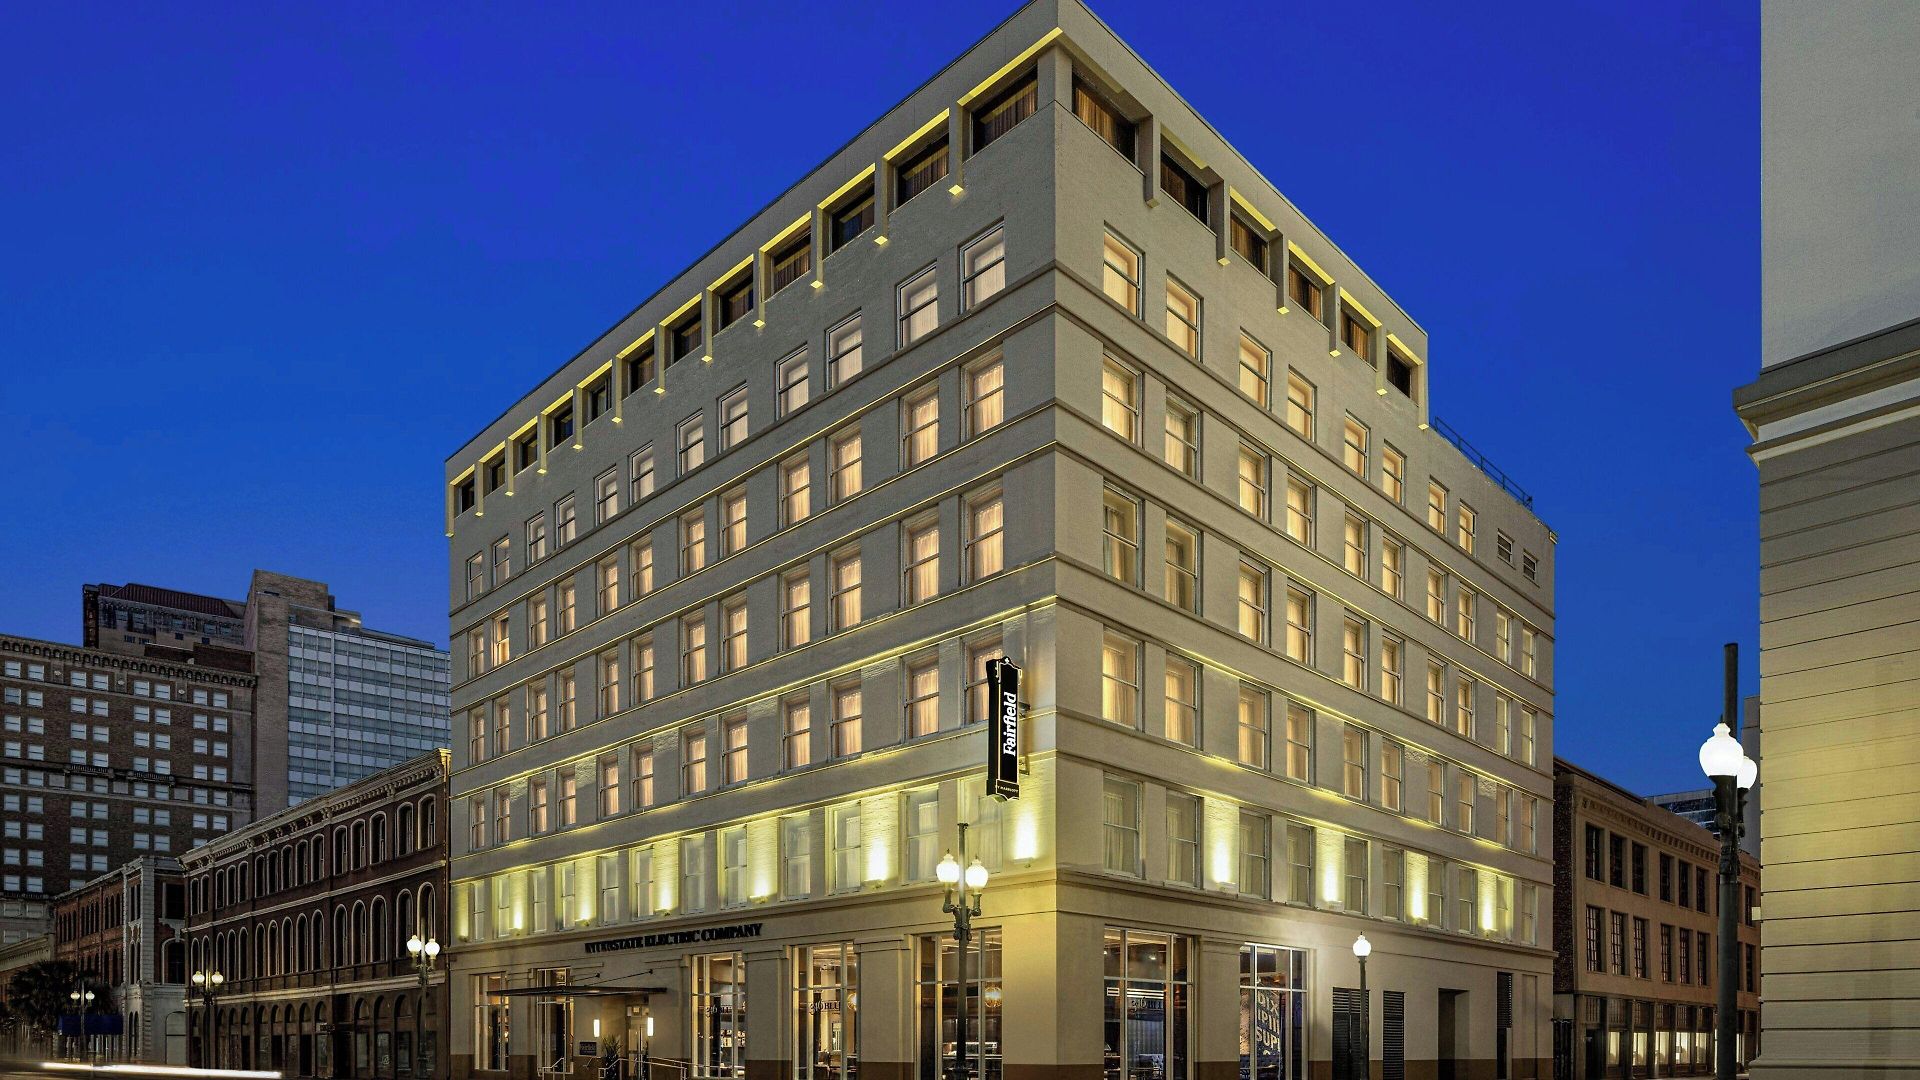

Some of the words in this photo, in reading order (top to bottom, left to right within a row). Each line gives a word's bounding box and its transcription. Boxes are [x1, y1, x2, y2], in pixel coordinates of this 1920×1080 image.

[1003, 691, 1017, 757] Fairfield
[585, 936, 643, 953] INTERSTATE
[645, 930, 700, 947] ELECTRIC
[701, 923, 763, 941] COMPANY
